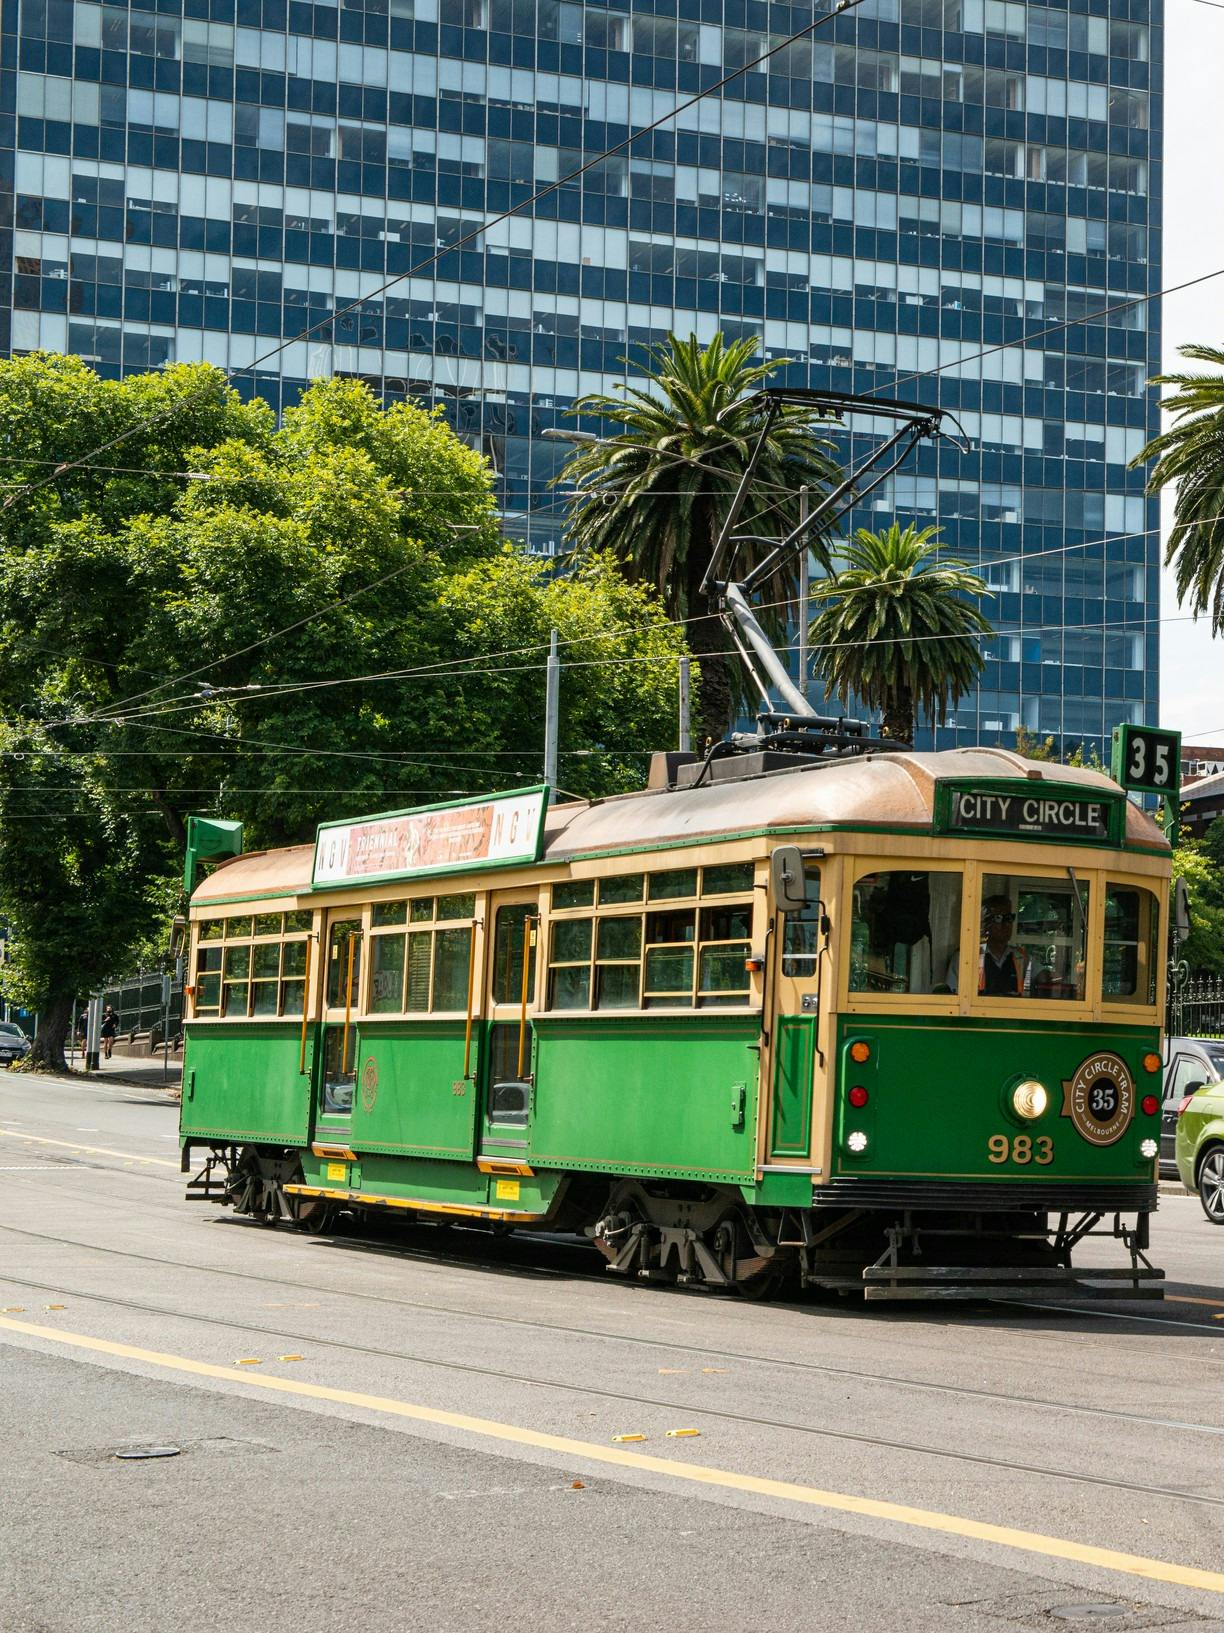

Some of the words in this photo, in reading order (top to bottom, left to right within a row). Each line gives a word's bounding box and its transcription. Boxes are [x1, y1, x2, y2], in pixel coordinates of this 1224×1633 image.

[1129, 737, 1169, 785] 35
[959, 795, 1012, 820] CITY
[1023, 799, 1100, 827] CIRCLE
[1075, 1080, 1086, 1113] CITY
[1084, 1060, 1120, 1080] CIRCLE
[1117, 1071, 1129, 1114] TRAM
[1092, 1088, 1115, 1111] 35
[1086, 1120, 1121, 1135] MELBOURNE
[988, 1134, 1053, 1165] 983
